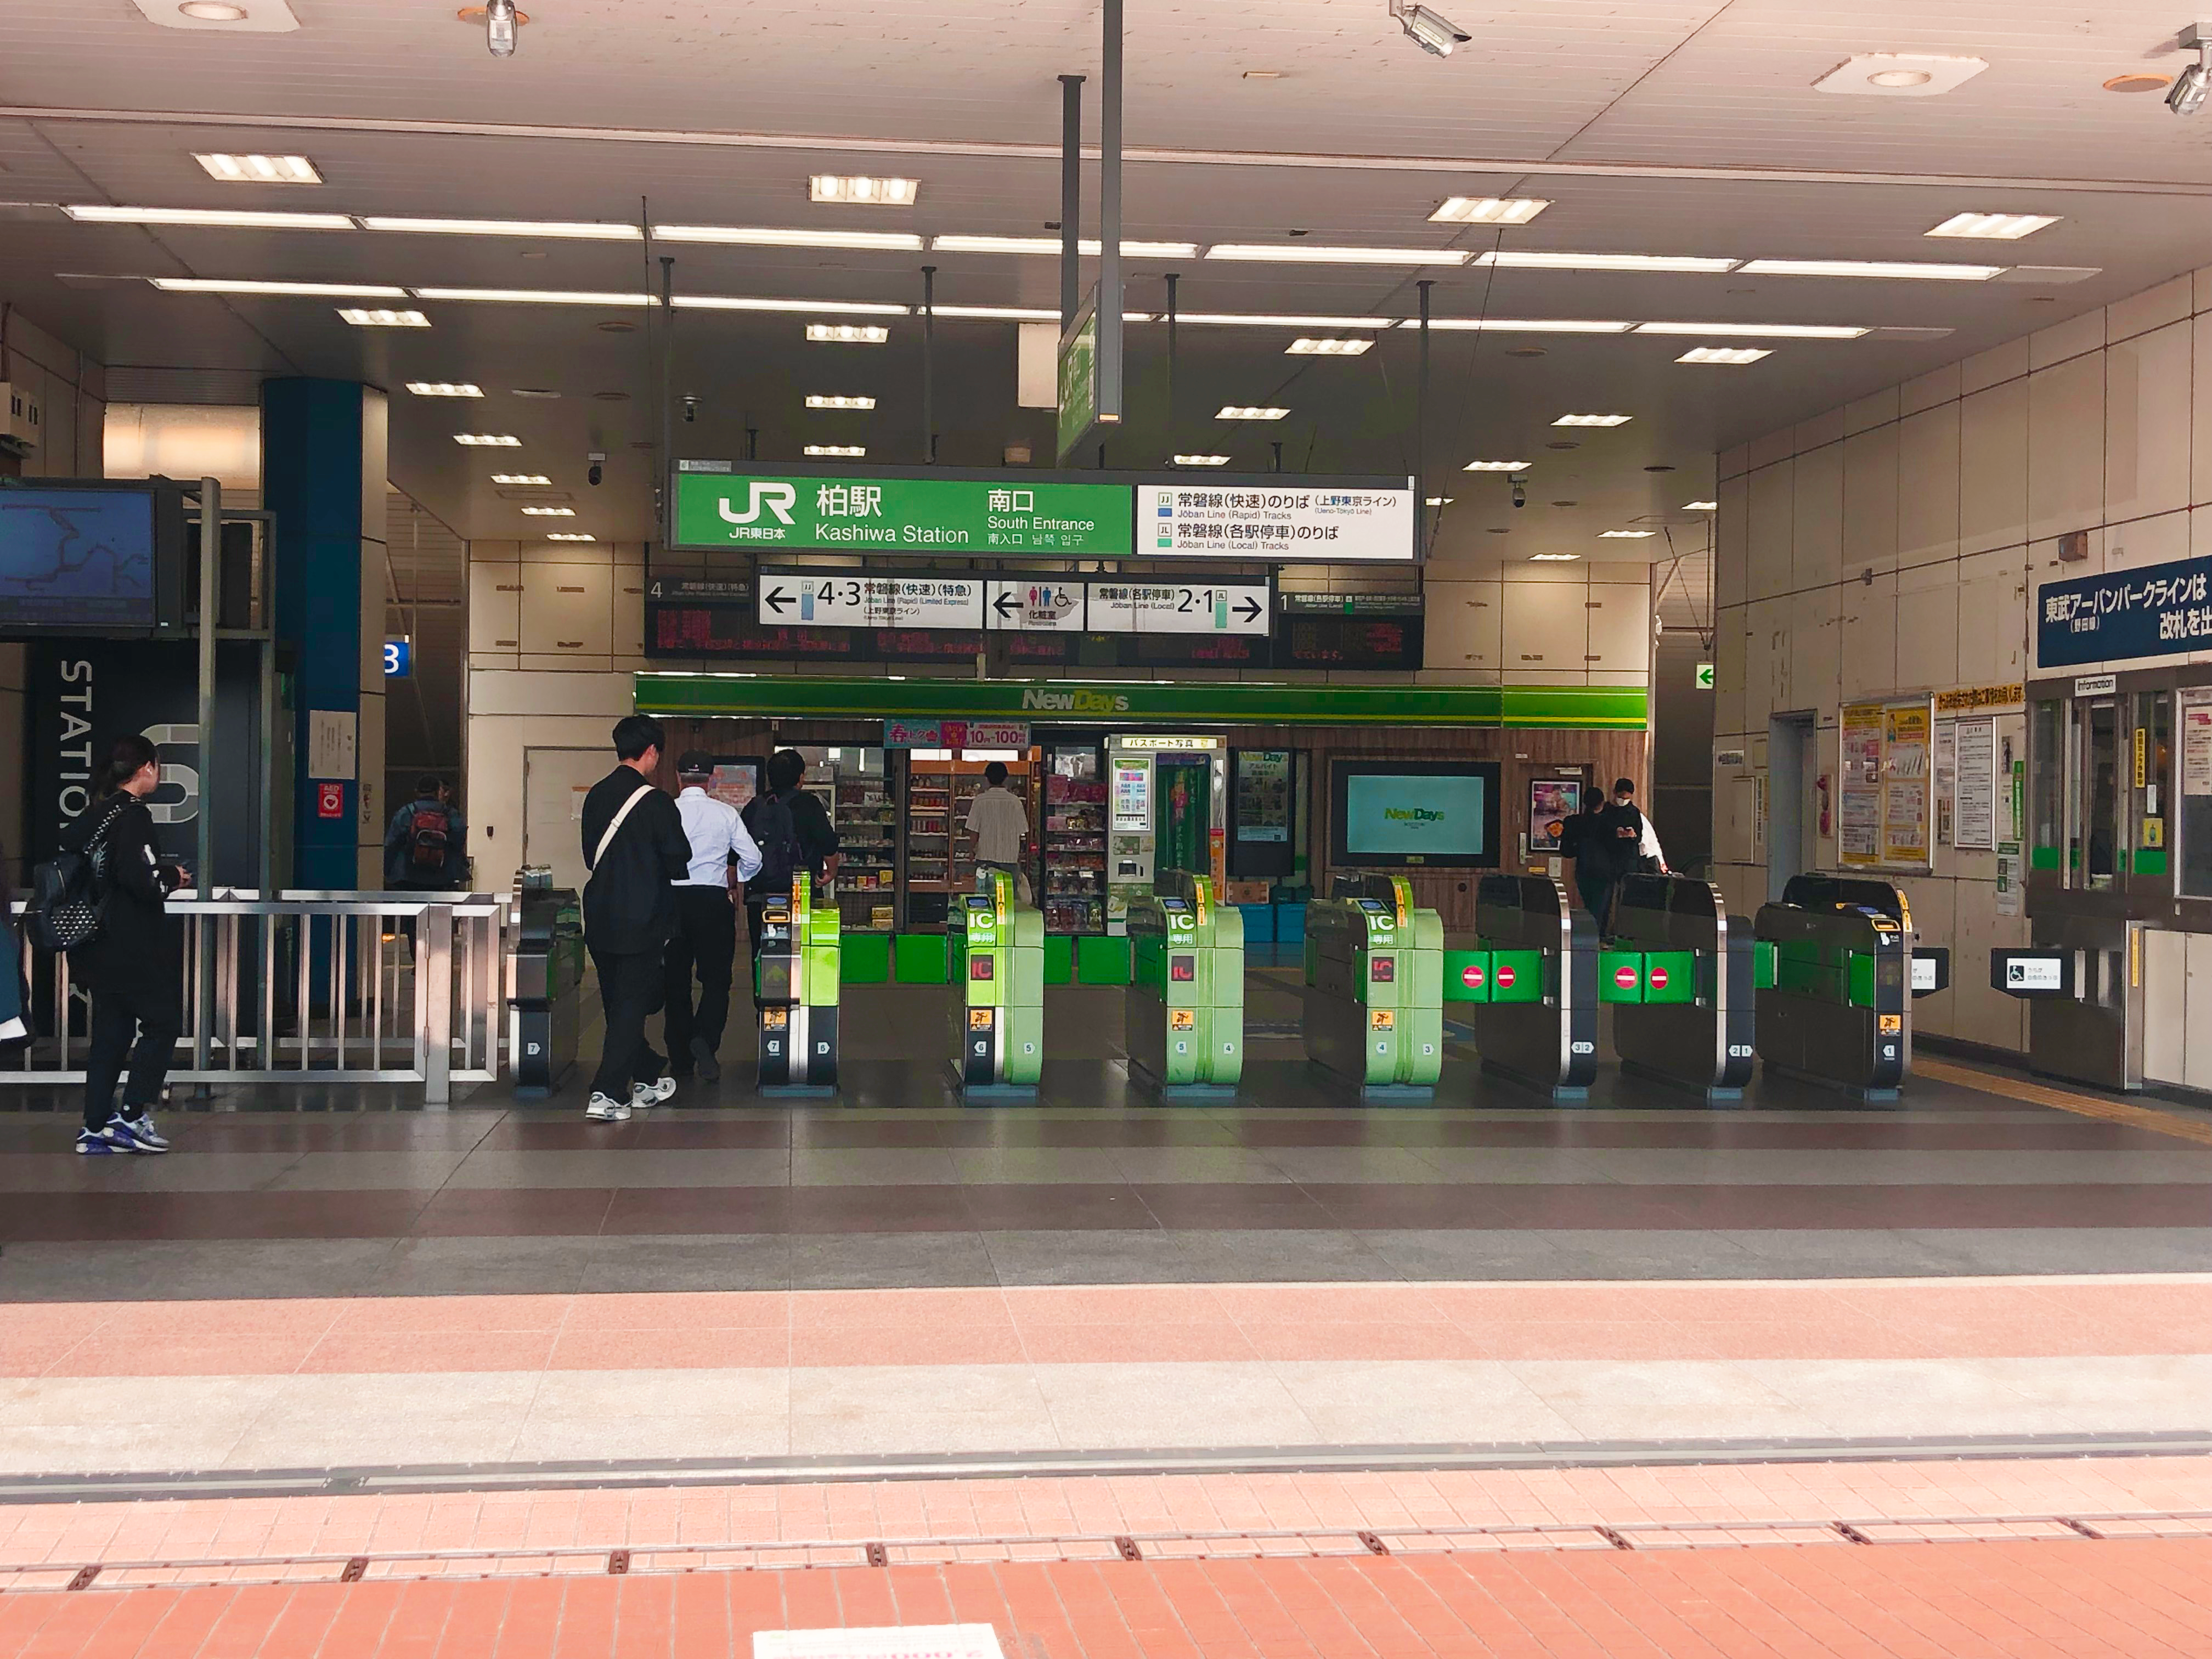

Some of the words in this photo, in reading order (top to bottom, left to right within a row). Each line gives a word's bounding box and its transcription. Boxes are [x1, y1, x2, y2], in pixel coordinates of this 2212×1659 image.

[719, 482, 797, 524] JR
[816, 484, 882, 517] 柏駅
[988, 489, 1034, 512] 南口
[1178, 493, 1309, 509] 常磐線(快速)のりば
[1314, 496, 1397, 507] (上野東京ライン)
[1207, 510, 1226, 518] Line
[1228, 511, 1261, 520] (Rapid)
[1263, 511, 1291, 520] Tracks
[988, 516, 1028, 529] South
[1032, 517, 1095, 531] Entrance
[729, 527, 786, 539] JR東日本
[815, 524, 895, 543] Kashiwa
[902, 525, 969, 544] Station
[988, 533, 1023, 545] 南入口
[1178, 524, 1339, 540] 常磐線(各駅停車)のりば
[1032, 533, 1055, 546] 남쪽
[1060, 533, 1084, 546] 입구
[1207, 541, 1226, 549] Line
[1228, 541, 1257, 550] (Local)
[1261, 541, 1289, 550] Tracks
[650, 582, 663, 598] 4
[864, 583, 971, 596] 常磐線(快速)(特急)
[1099, 588, 1174, 600] 常磐線(各駅停車)
[1281, 595, 1287, 611] 1
[2045, 573, 2207, 623] 東武アーバンパークラインは
[1029, 611, 1056, 619] 化粧室
[2159, 606, 2212, 640] 改札を出
[385, 644, 399, 673] 3
[2078, 679, 2113, 691] Information
[1022, 690, 1128, 712] NewDays
[1130, 738, 1193, 748] パスポート写真
[59, 661, 92, 851] STATIO
[1385, 808, 1444, 821] NewDays
[969, 913, 994, 928] IC
[1170, 915, 1194, 929] IC
[1369, 916, 1395, 930] IC
[972, 932, 993, 943] 専用
[1173, 934, 1193, 944] 専用
[1373, 934, 1393, 944] 専用
